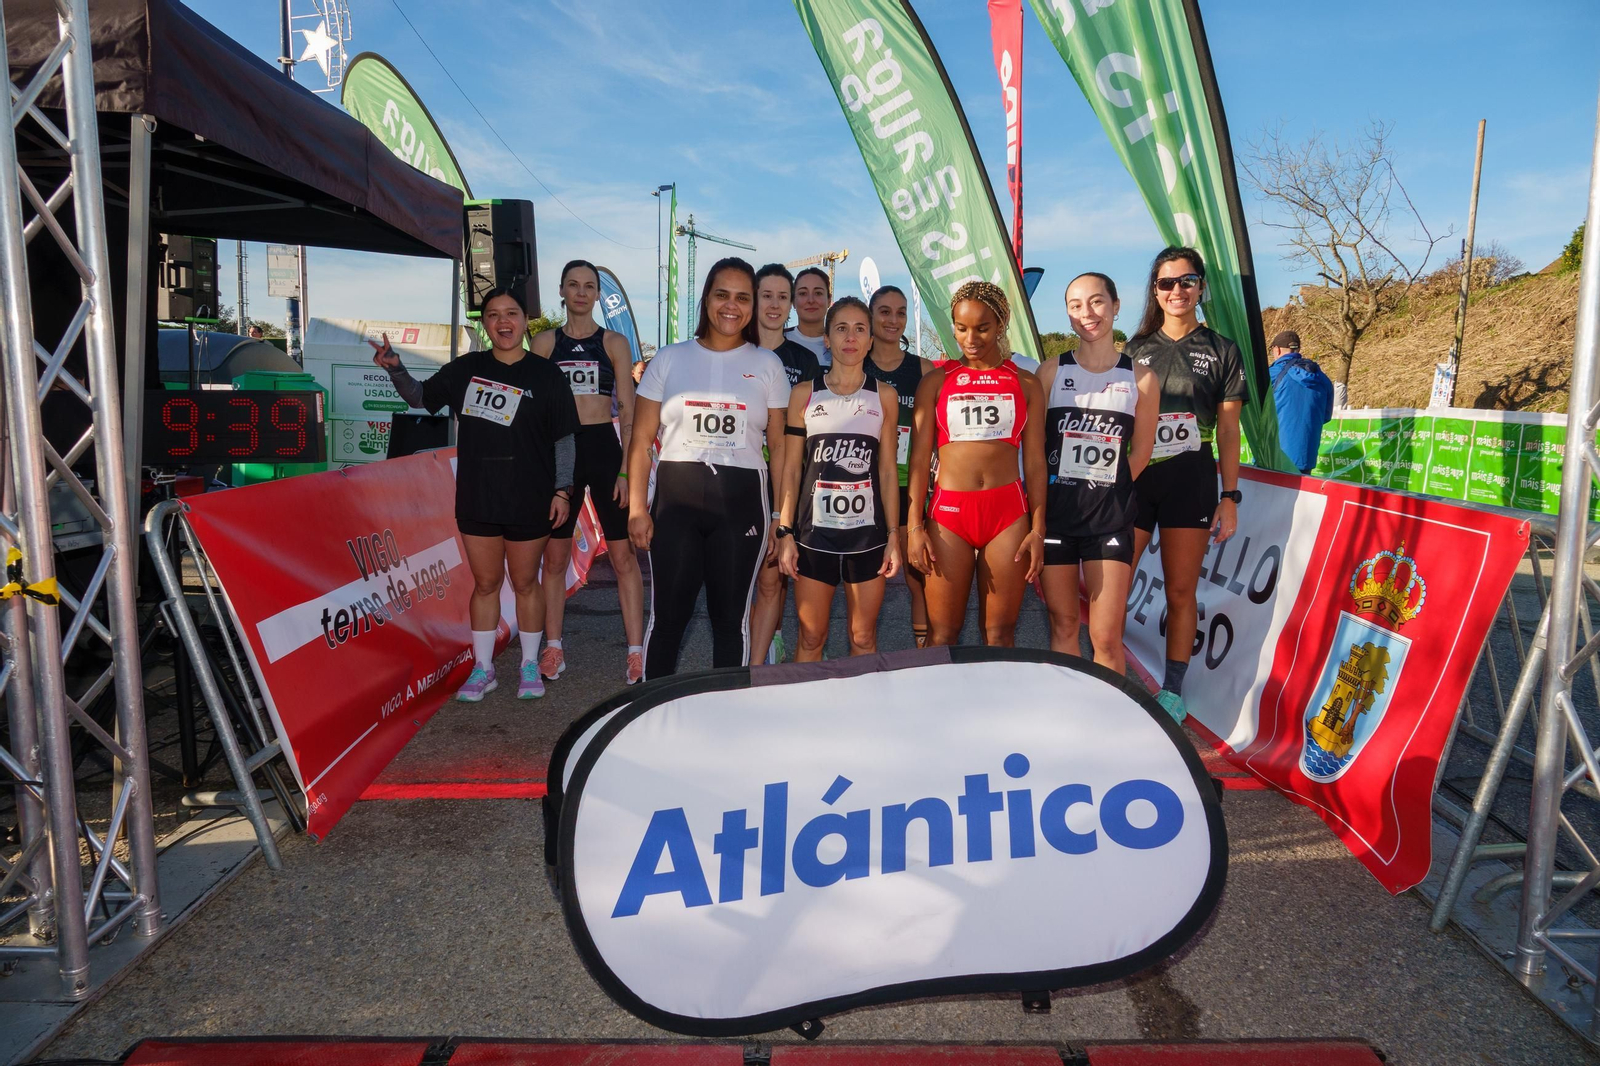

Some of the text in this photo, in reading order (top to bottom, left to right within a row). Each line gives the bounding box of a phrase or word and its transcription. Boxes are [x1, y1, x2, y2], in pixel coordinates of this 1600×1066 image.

[1192, 367, 1208, 376] VIGO
[475, 389, 507, 410] 110
[692, 413, 736, 435] 108
[960, 405, 1000, 426] 113
[162, 398, 307, 456] 9:39
[1155, 423, 1189, 443] 06
[847, 460, 864, 469] fresh
[1072, 444, 1117, 467] 109
[1520, 476, 1539, 489] máis
[822, 494, 866, 515] 100
[346, 528, 410, 582] VIGO,
[320, 558, 451, 650] terreo de xogo
[1126, 568, 1166, 626] DE
[381, 692, 403, 720] VIGO,
[406, 684, 415, 701] A
[417, 660, 453, 695] MELLOR
[610, 752, 1185, 919] Atlántico
